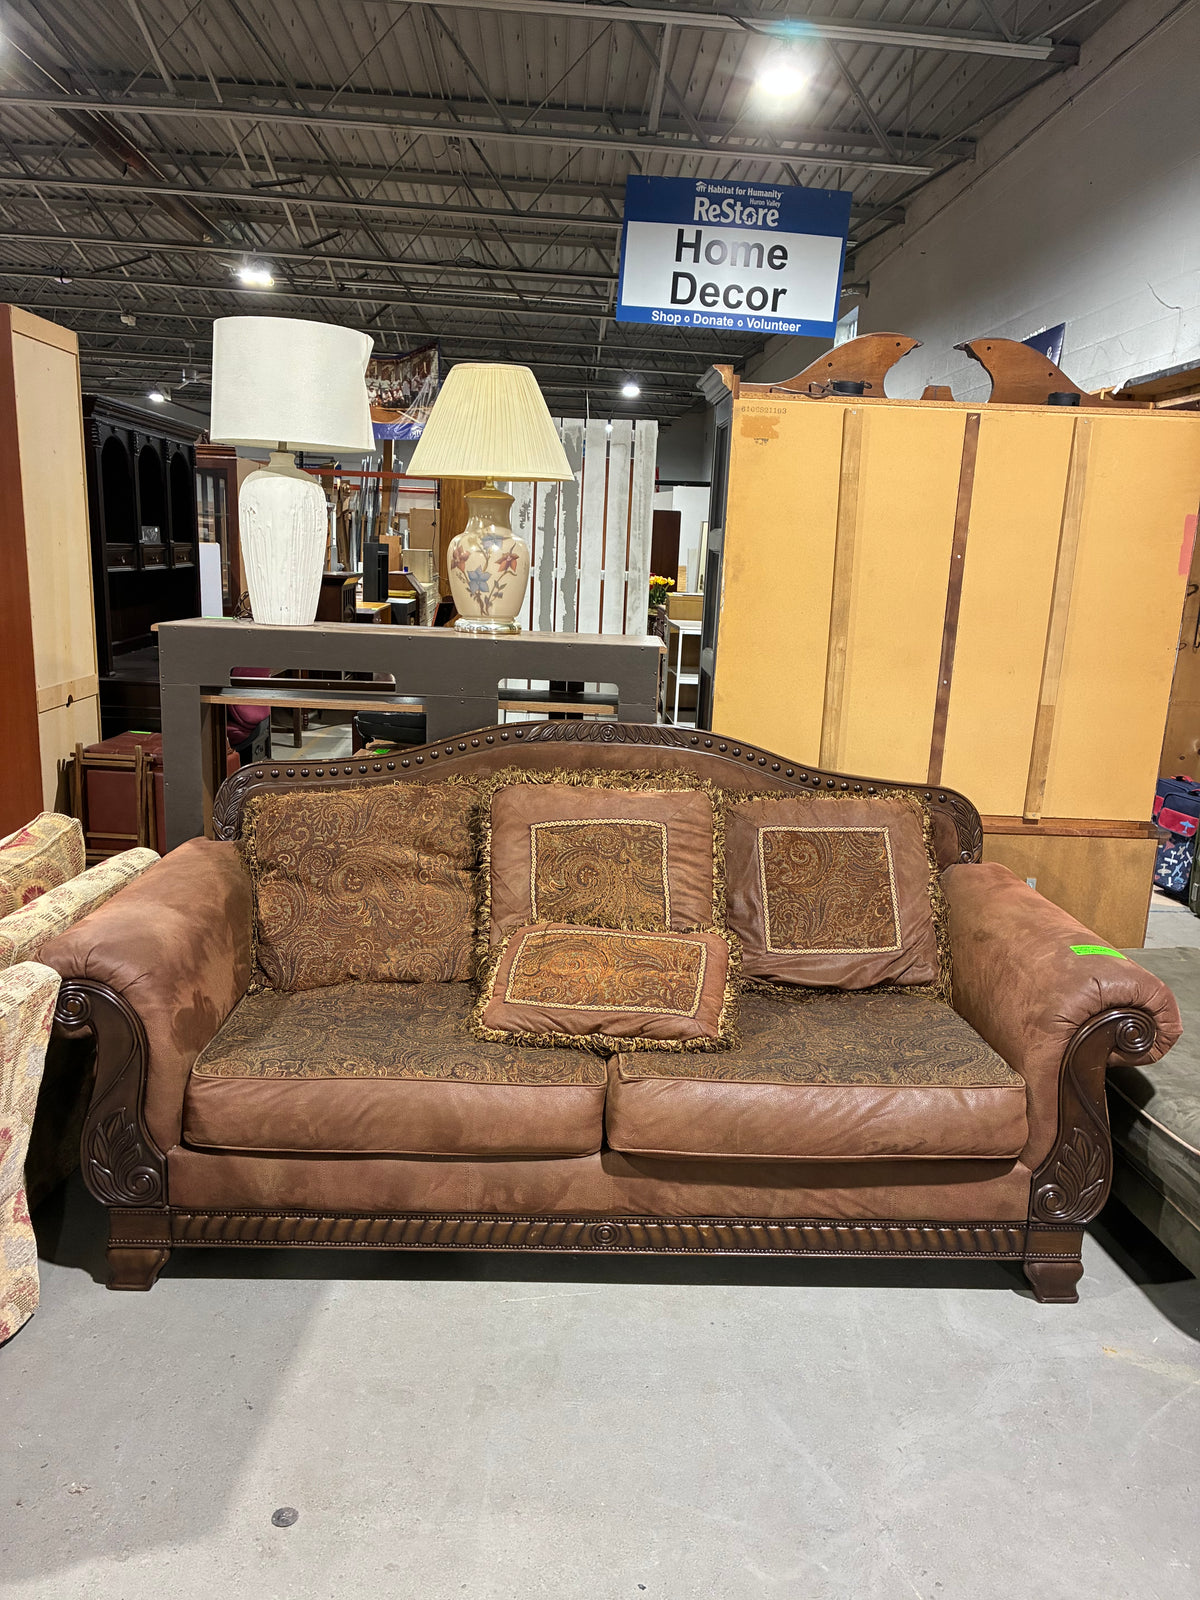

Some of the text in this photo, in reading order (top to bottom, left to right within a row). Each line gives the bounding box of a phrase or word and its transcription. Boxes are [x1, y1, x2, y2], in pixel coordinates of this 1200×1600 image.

[707, 184, 782, 199] Habitat for Humanity
[750, 198, 781, 209] Huron Valley
[693, 196, 779, 227] ReStore
[675, 228, 788, 270] Home
[670, 271, 787, 312] Decor
[651, 310, 801, 332] Shop Donate Volunteer
